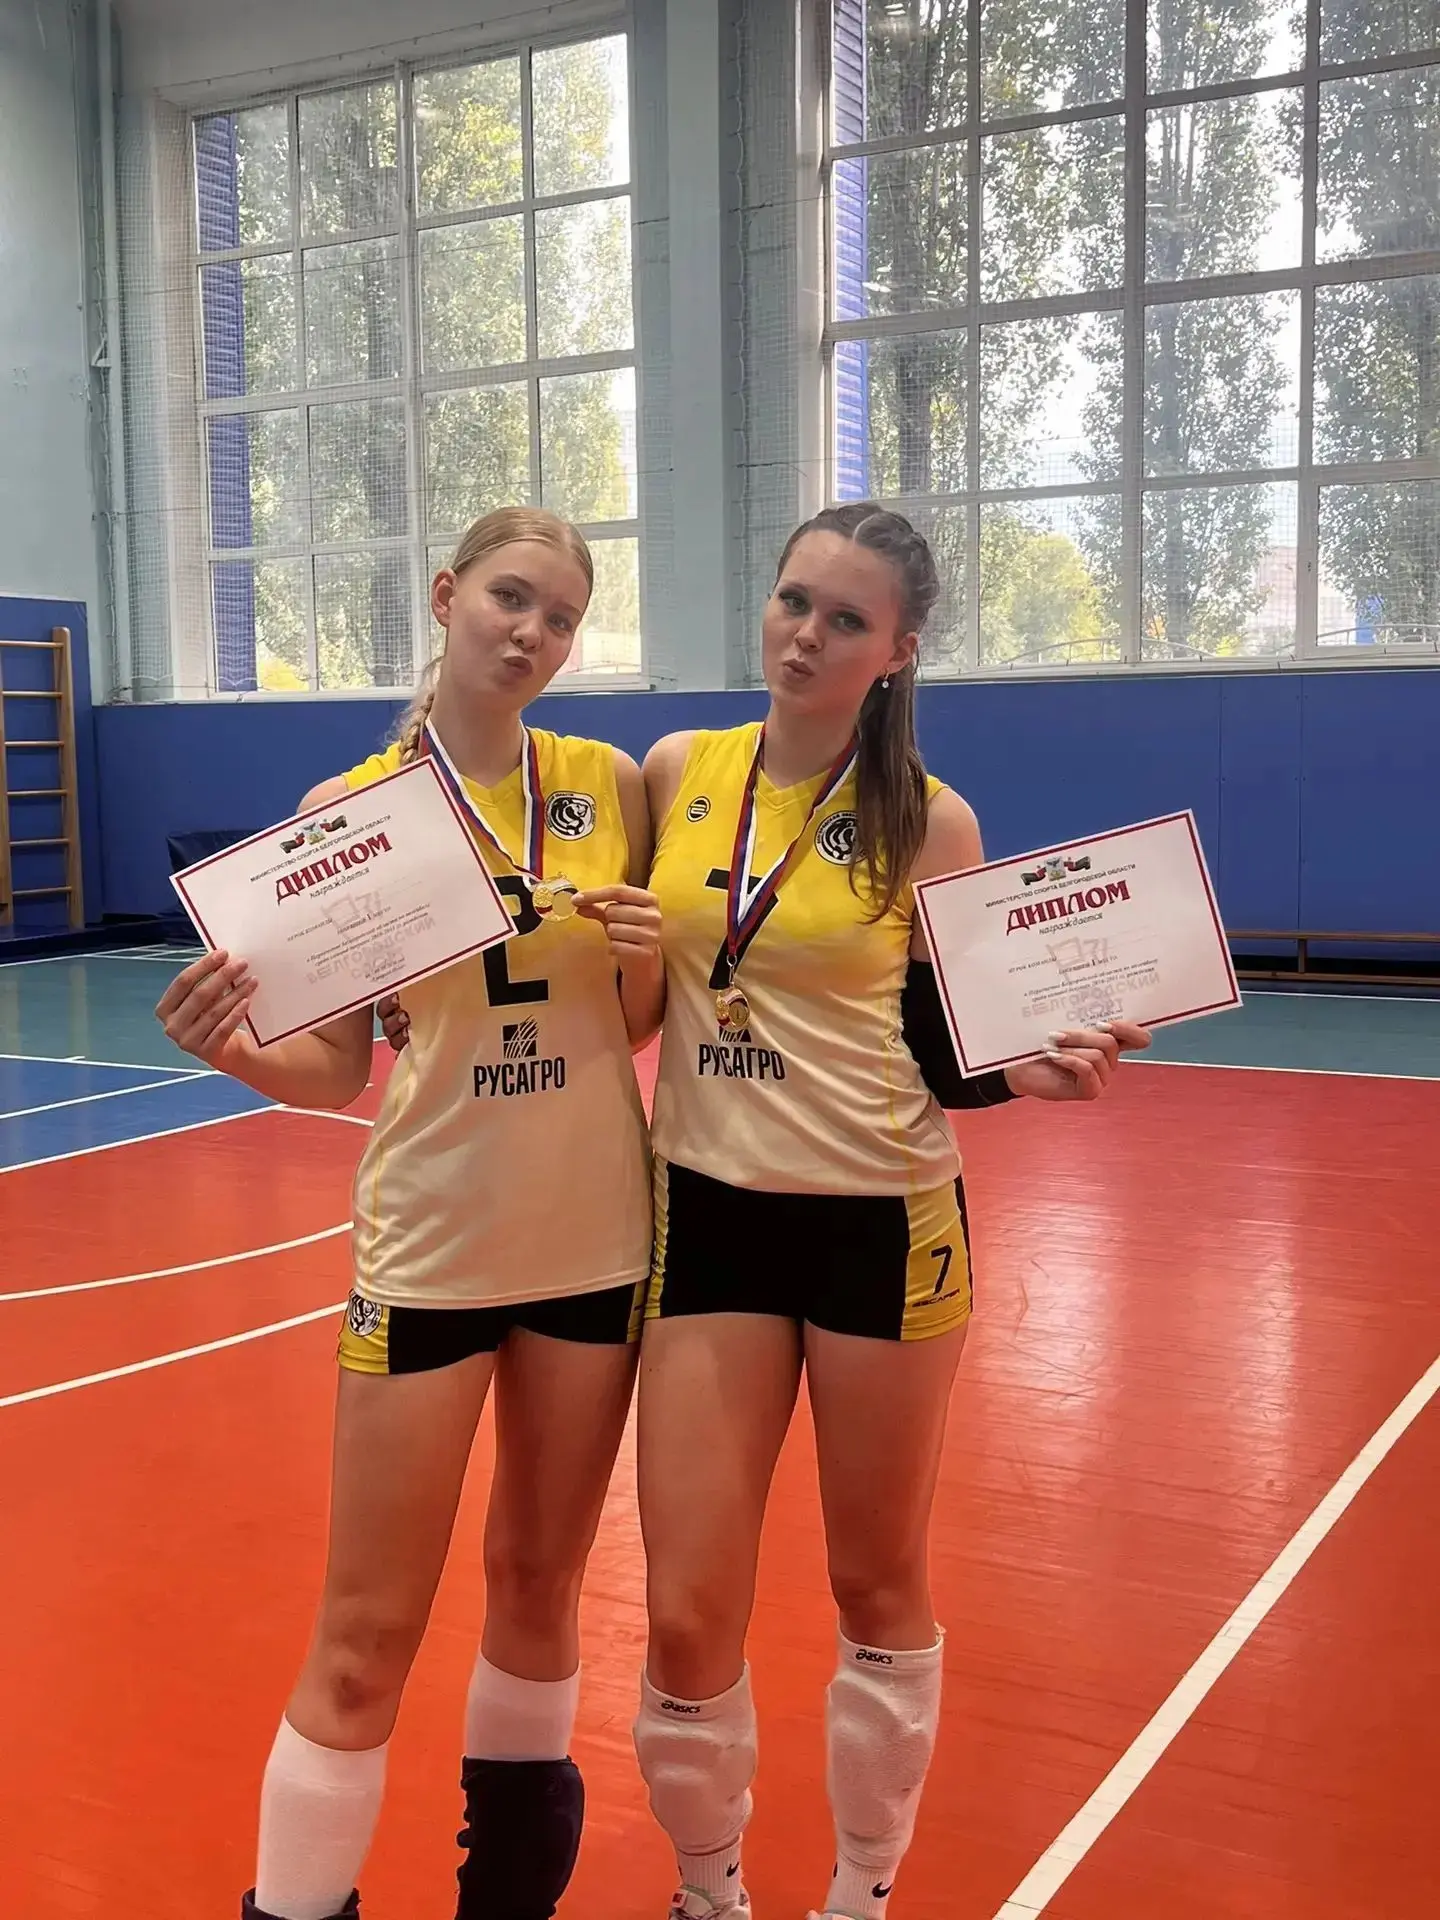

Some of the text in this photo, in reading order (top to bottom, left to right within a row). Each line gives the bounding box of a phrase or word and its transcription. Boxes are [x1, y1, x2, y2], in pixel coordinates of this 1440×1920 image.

[250, 814, 391, 882] МИНИСТЕРСТВО СПОРТА БЕЛГОРОДСКОЙ ОБЛАСТИ
[276, 832, 392, 906] ДИПЛОМ
[310, 867, 369, 899] награждается
[985, 863, 1136, 908] МИНИСТЕРСТВО СПОРТА БЕЛГОРОДСКОЙ ОБЛАСТИ
[1006, 879, 1131, 936] ДИПЛОМ
[1039, 912, 1103, 935] награждается
[473, 1056, 566, 1098] РУСАГРО
[698, 1044, 786, 1081] РУСАГРО
[931, 1244, 953, 1296] 7
